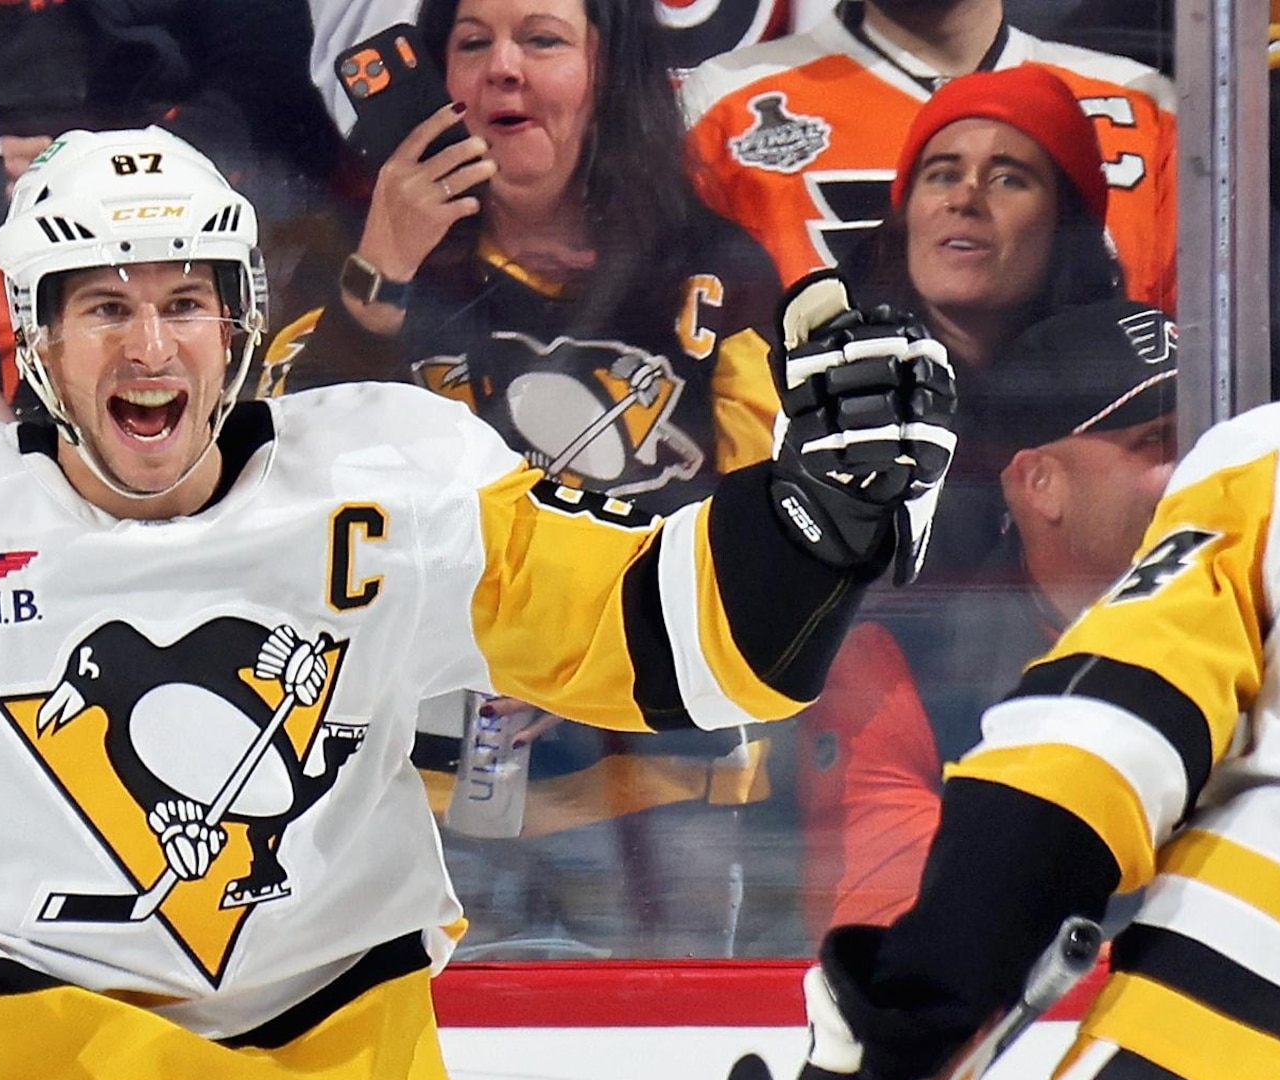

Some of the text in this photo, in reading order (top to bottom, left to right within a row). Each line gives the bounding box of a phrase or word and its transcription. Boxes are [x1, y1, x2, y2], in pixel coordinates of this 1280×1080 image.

[111, 153, 163, 176] 87
[111, 206, 185, 222] CCM
[675, 273, 724, 361] C
[780, 497, 821, 544] CCM
[326, 501, 388, 615] C
